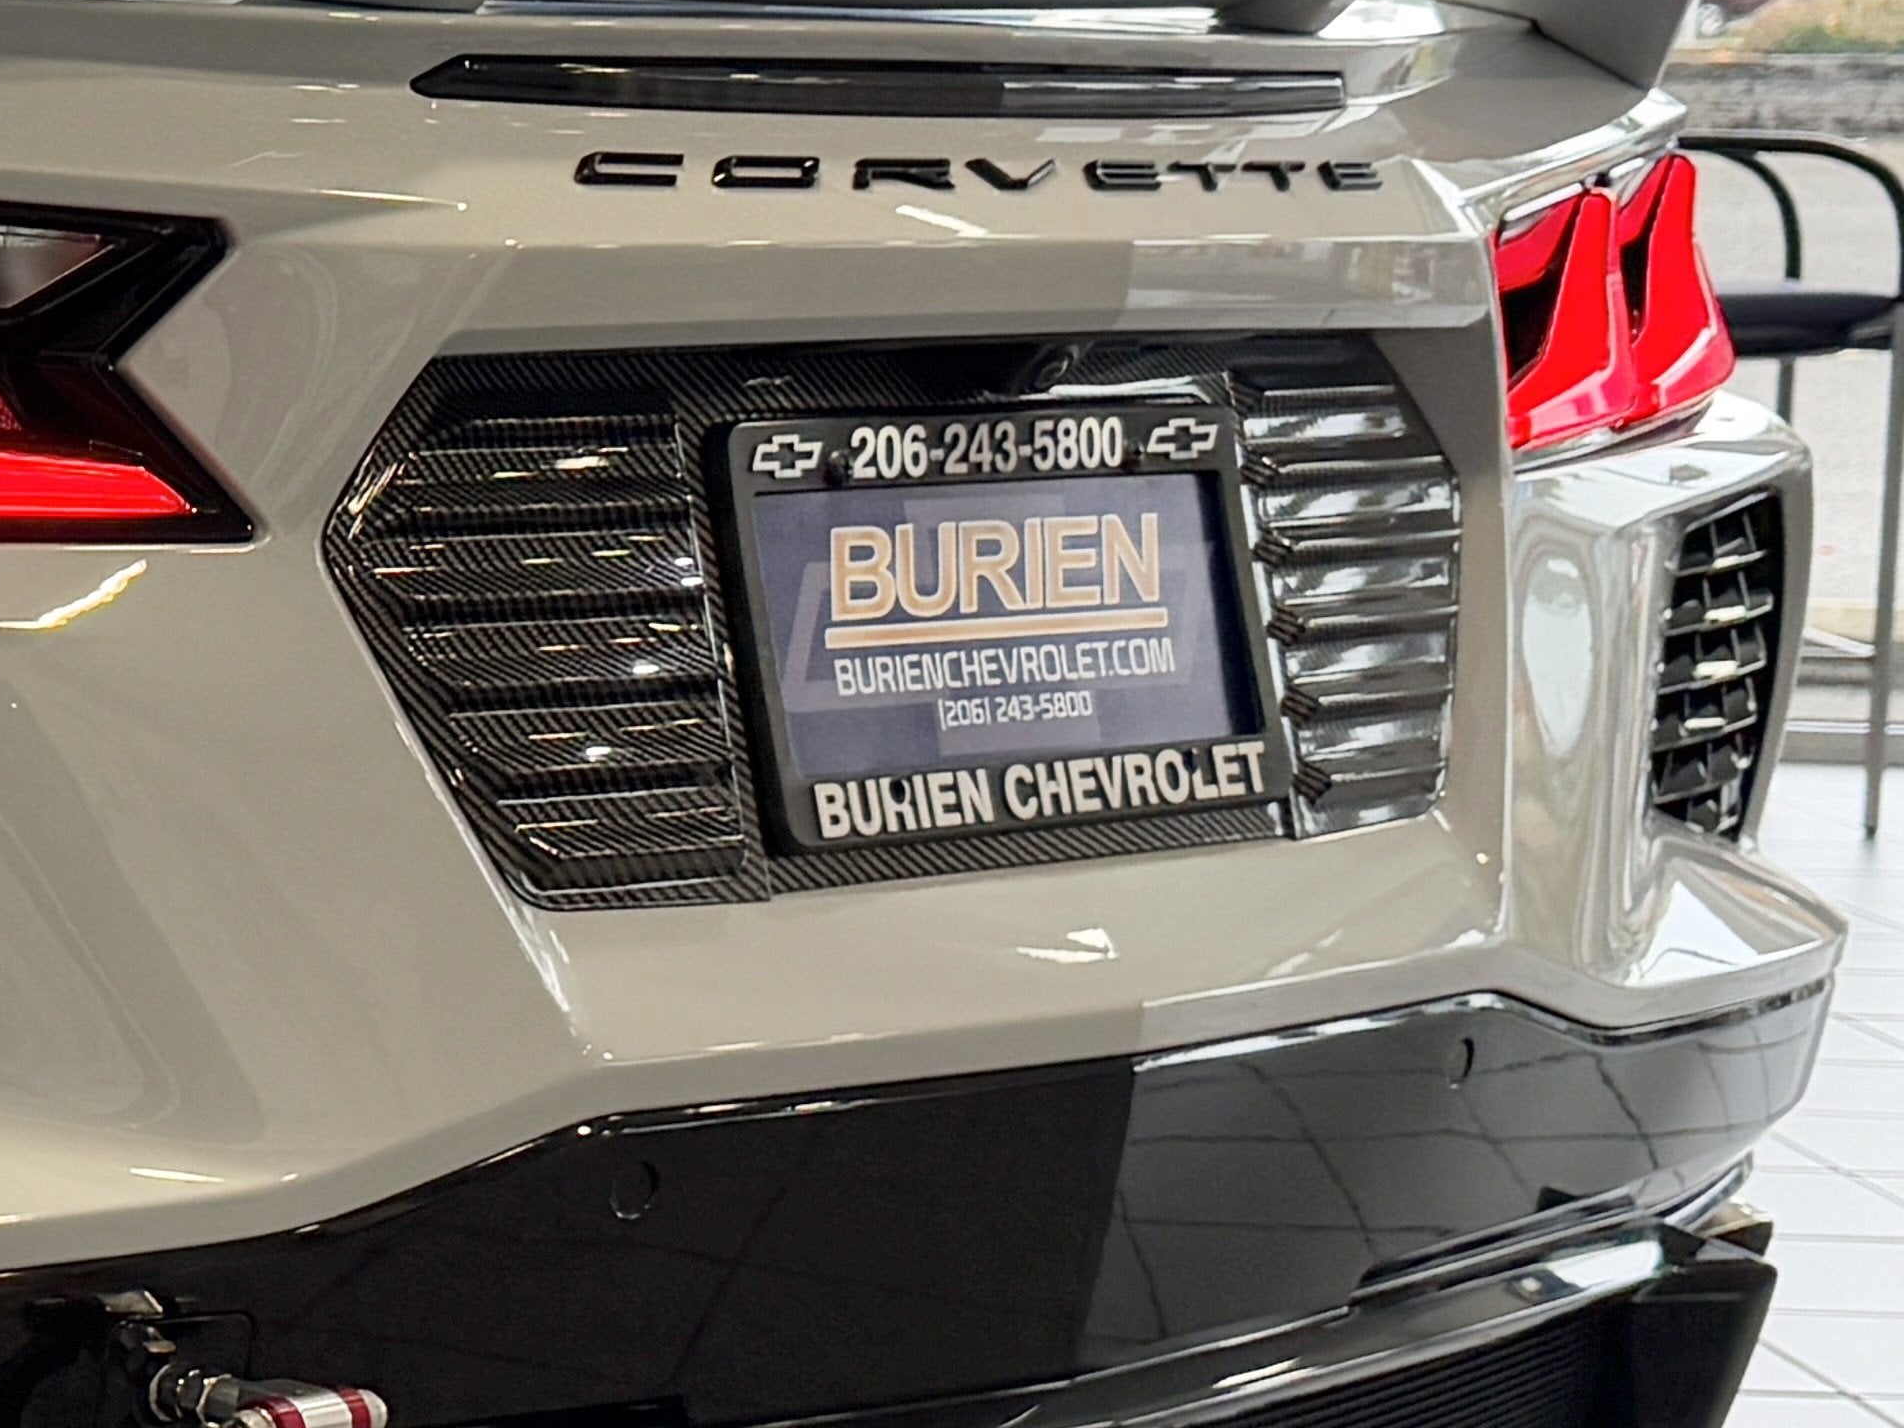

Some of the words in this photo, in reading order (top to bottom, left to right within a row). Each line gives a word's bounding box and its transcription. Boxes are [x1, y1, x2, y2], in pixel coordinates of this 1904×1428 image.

[574, 151, 1383, 193] CORVETTE
[849, 417, 1123, 480] 206-243-5800
[830, 512, 1160, 622] BURIEN
[834, 636, 1176, 698] BURIENCHEVROLET.COM
[995, 689, 1094, 724] 243-5800
[813, 768, 995, 840] BURIEN
[1003, 740, 1266, 822] CHEVROLET
